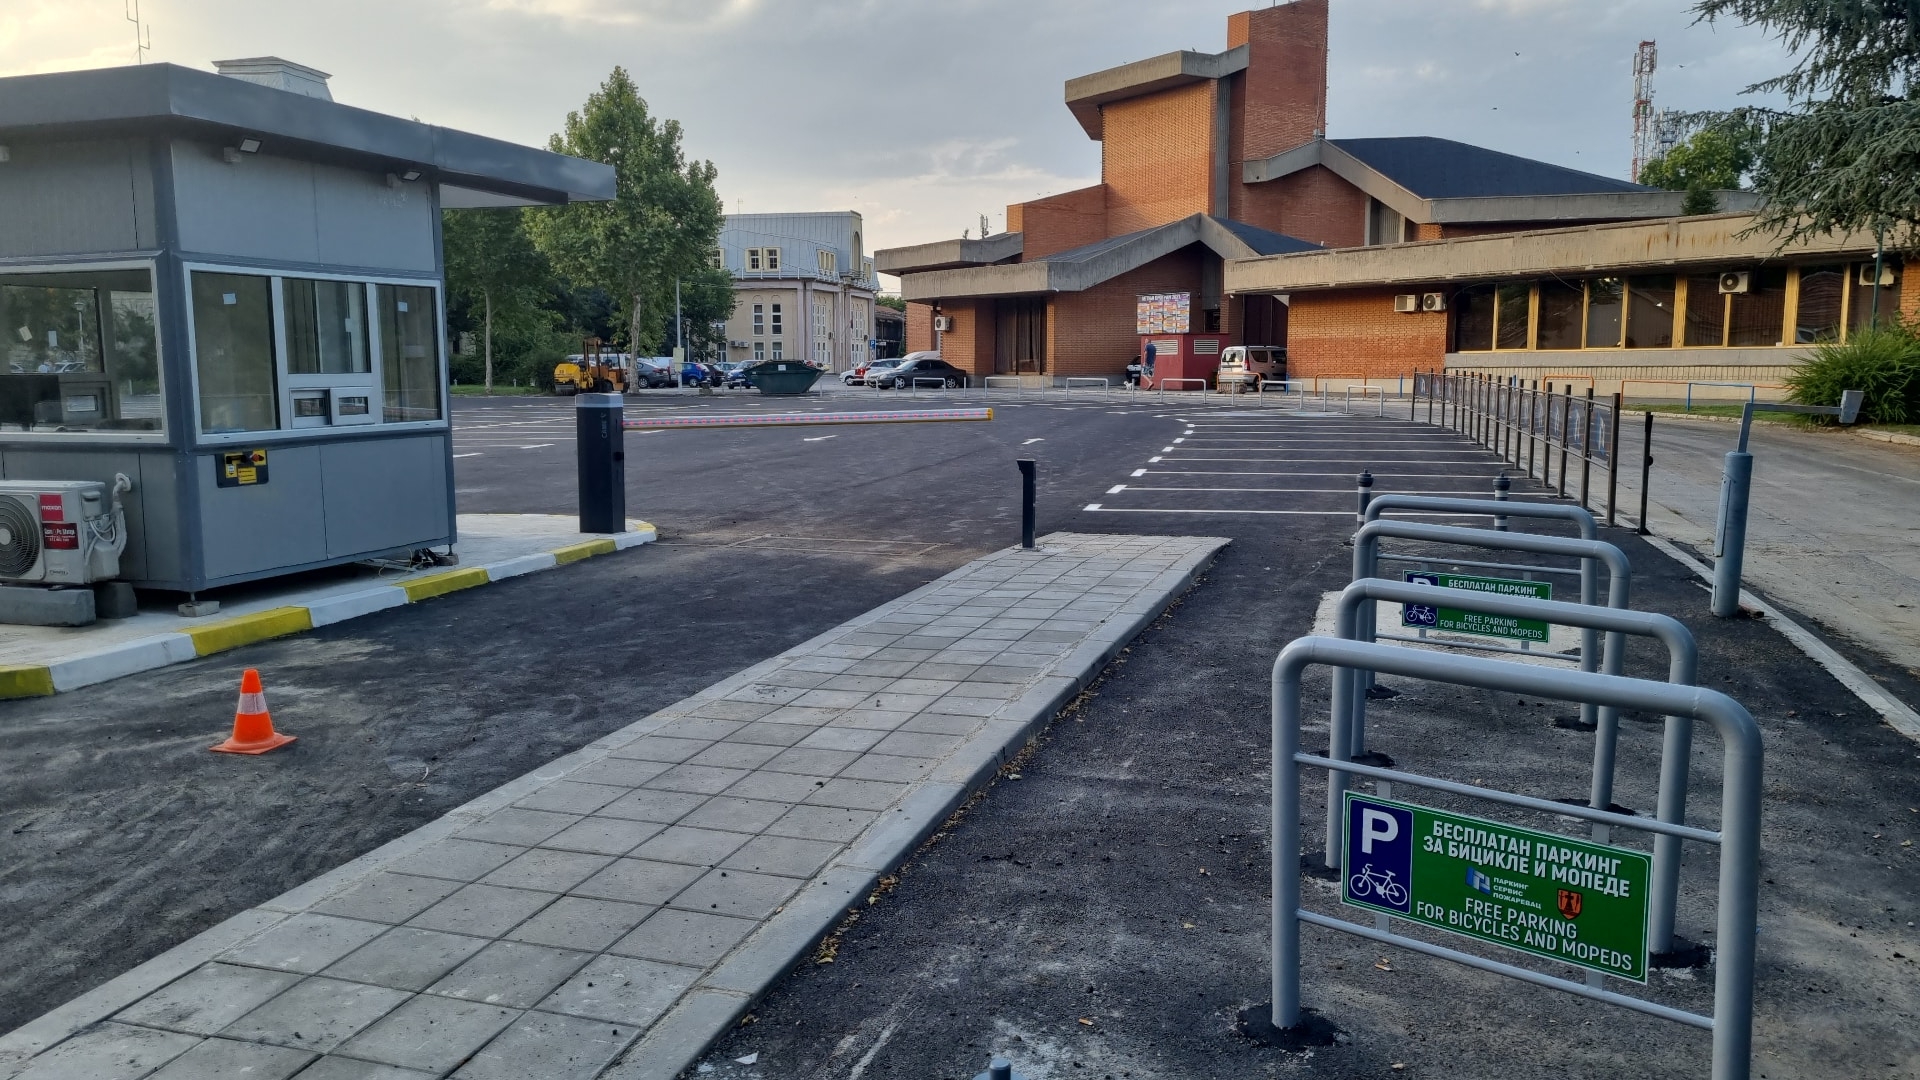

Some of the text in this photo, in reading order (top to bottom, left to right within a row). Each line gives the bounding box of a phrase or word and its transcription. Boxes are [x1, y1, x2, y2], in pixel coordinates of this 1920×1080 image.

[1448, 579, 1538, 595] БЕСПЛАТАН ПАРКИНГ
[1440, 619, 1543, 639] FOR BICYCLES AND MOPEDS
[1464, 614, 1518, 628] FREE PARKING
[1362, 807, 1399, 855] P
[1433, 820, 1622, 876] БЕСПЛАТАН ПАРКИНГ
[1423, 836, 1630, 898] ЗА БИЦИКЛЕ И МОПЕДЕ
[1493, 877, 1529, 891] ПАРКИНГ
[1493, 884, 1524, 897] СЕРВИС
[1493, 892, 1542, 910] ПОЖАРЕВАЦ
[1465, 897, 1577, 939] FREE PARKING
[1416, 901, 1633, 971] FOR BICYCLES AND MOPEDS
